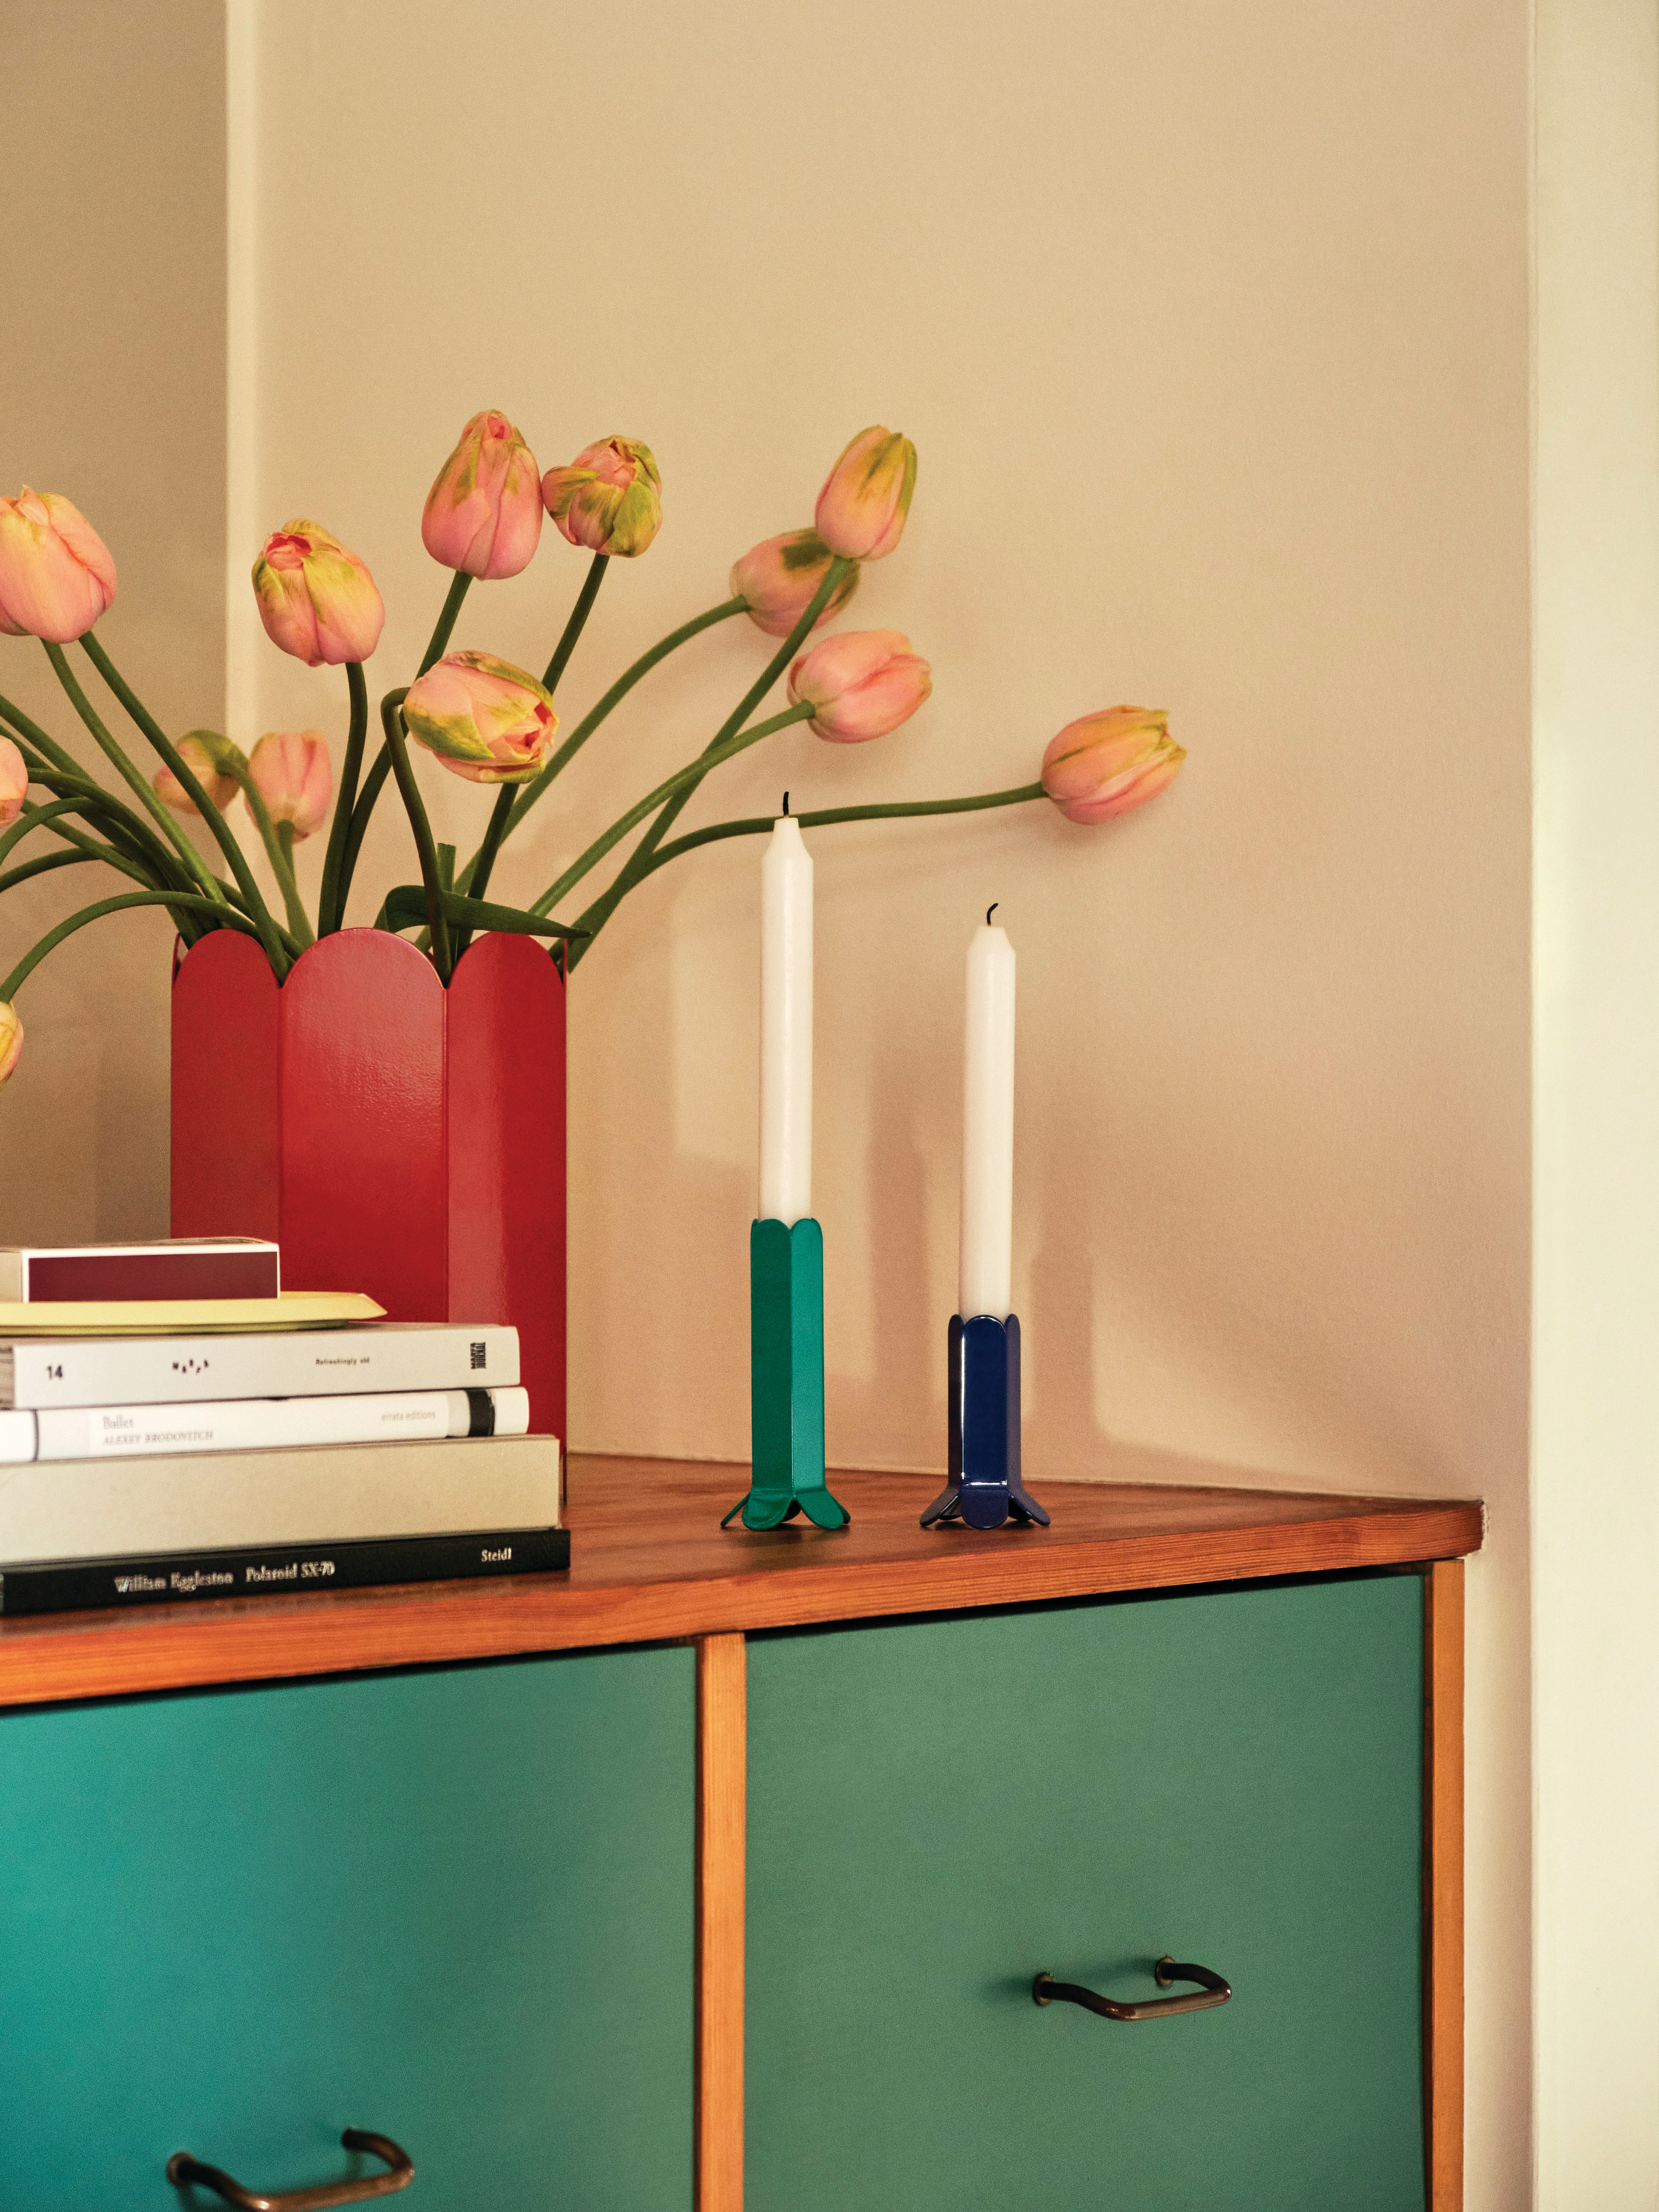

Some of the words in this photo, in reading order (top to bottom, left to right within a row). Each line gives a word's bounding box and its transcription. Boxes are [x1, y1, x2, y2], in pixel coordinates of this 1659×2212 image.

[46, 1365, 63, 1380] 14
[103, 1414, 134, 1429] Ballet
[381, 1413, 403, 1421] errata
[406, 1410, 436, 1420] editions
[103, 1434, 140, 1445] ALEXEY
[145, 1430, 214, 1443] BRODOVITCH
[481, 1547, 512, 1562] Steidl
[114, 1574, 166, 1593] William
[170, 1570, 234, 1593] Eggleston
[246, 1562, 298, 1582] Polaroid
[301, 1560, 336, 1578] SX-70
